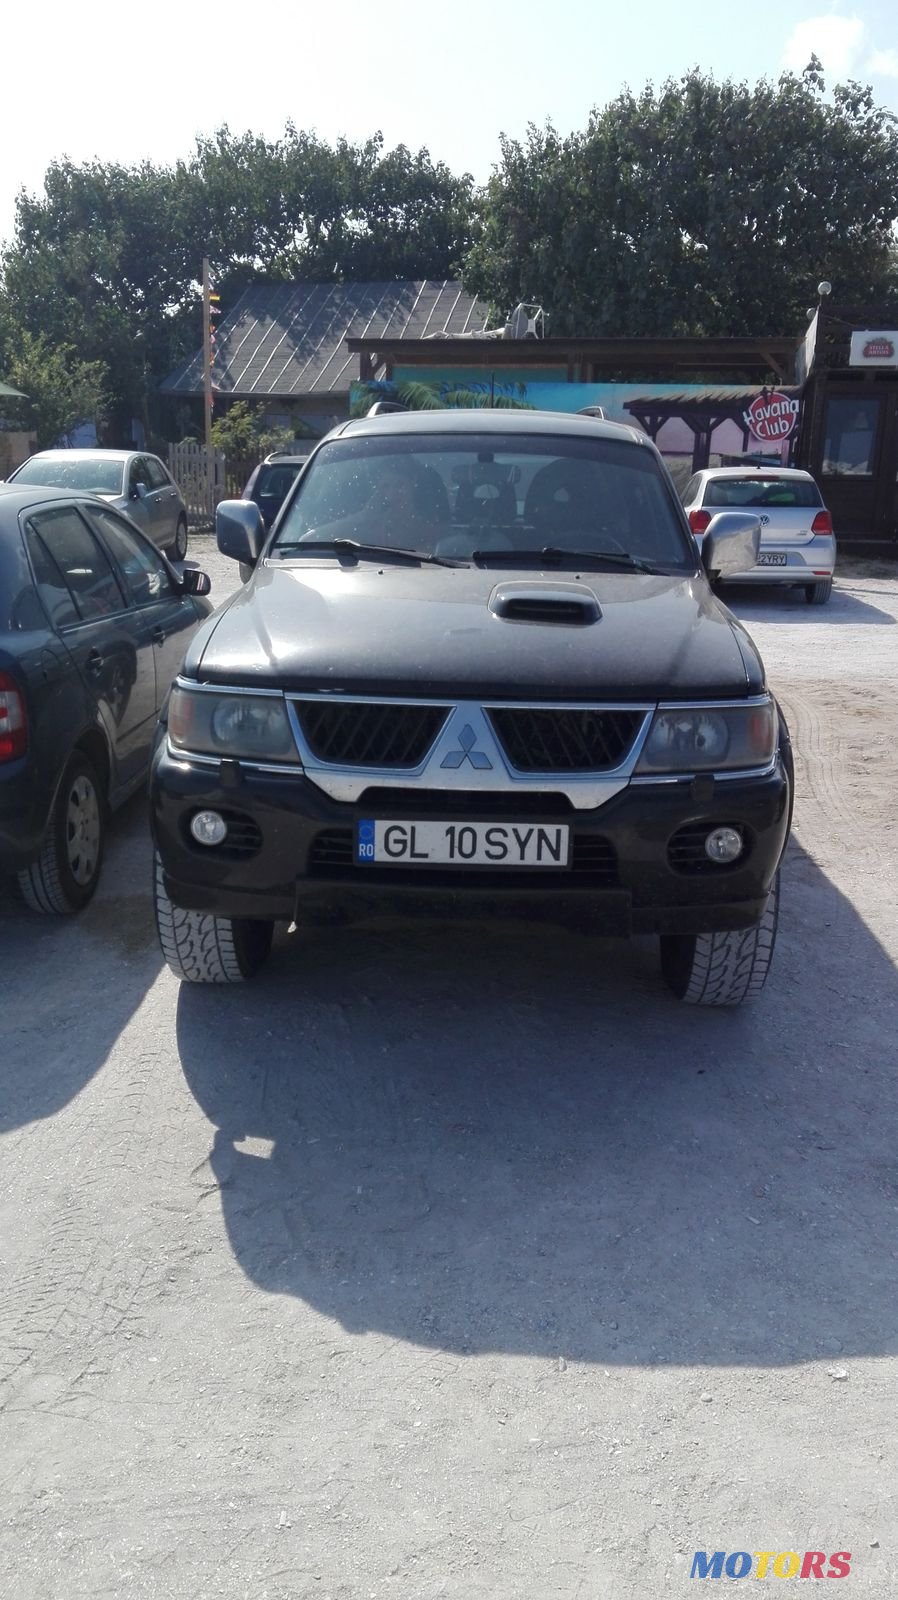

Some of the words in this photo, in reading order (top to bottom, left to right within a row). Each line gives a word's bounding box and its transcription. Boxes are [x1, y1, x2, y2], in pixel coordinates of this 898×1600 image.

[742, 399, 800, 426] Havana
[755, 417, 790, 437] Club
[358, 844, 374, 857] RO
[383, 825, 429, 859] GL
